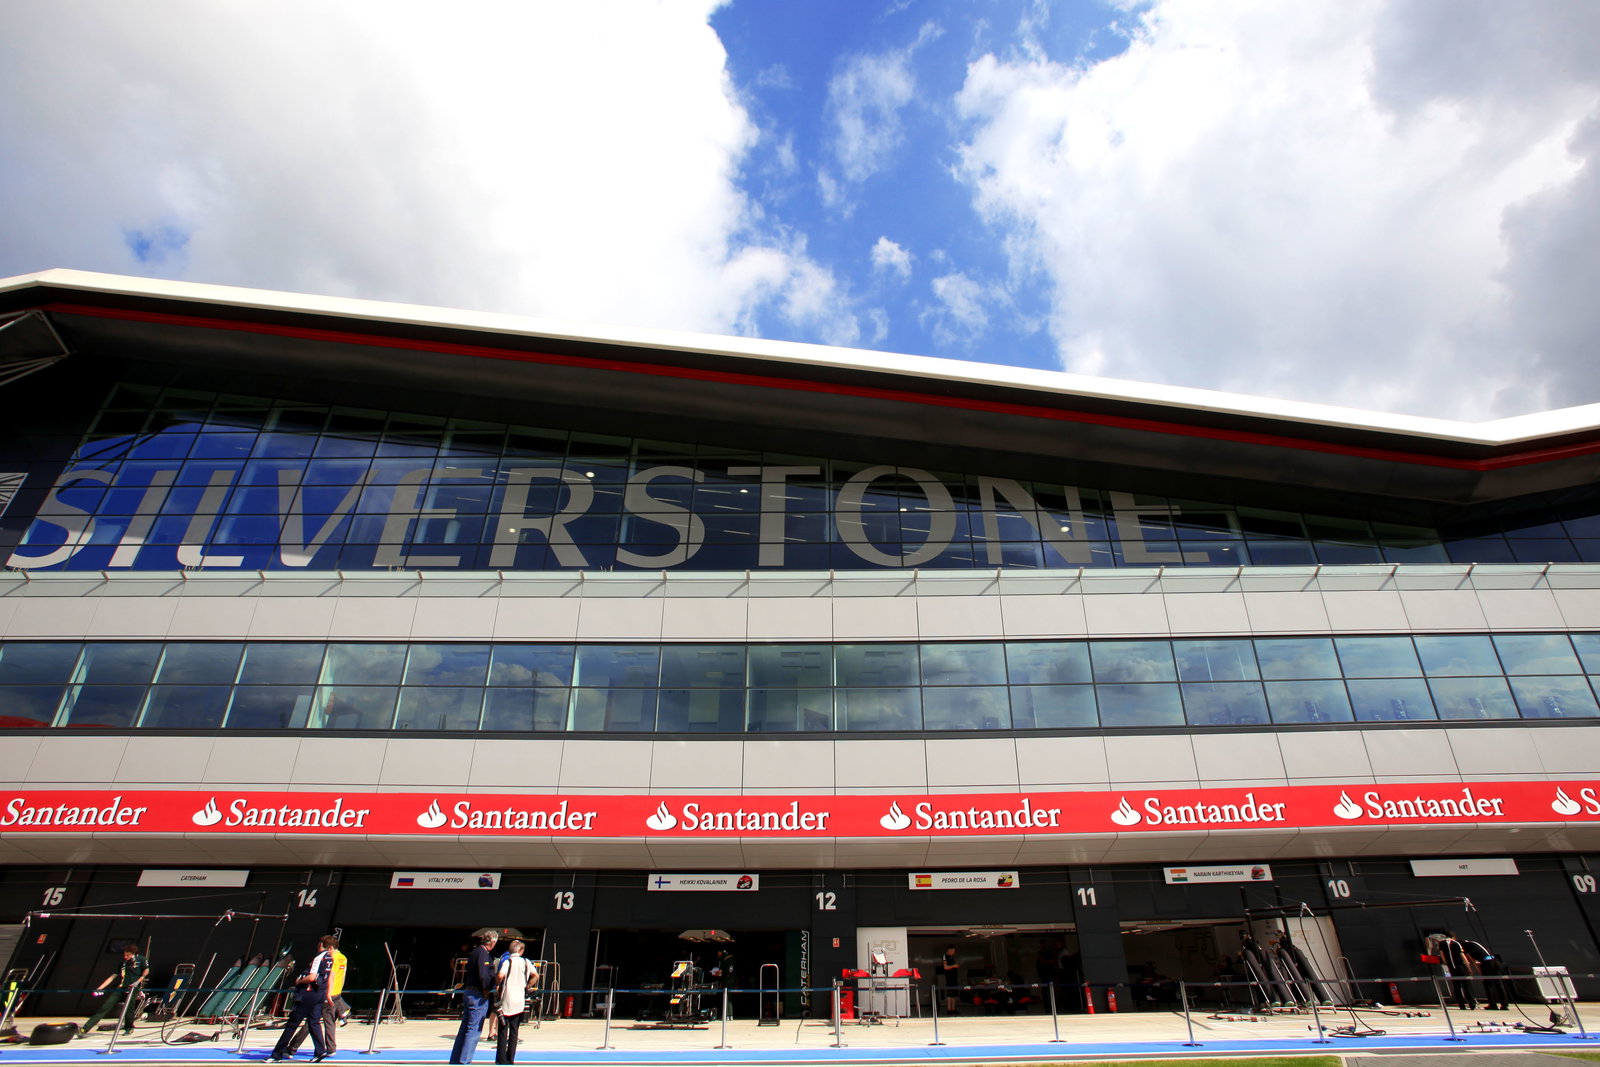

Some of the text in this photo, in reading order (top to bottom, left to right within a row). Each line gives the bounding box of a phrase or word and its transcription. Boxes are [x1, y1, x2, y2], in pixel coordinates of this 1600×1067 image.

[6, 466, 1209, 569] SILVERSTONE
[0, 796, 148, 826] Santander
[225, 798, 370, 828] Santander
[450, 800, 597, 830] Santander
[681, 800, 830, 831] Santander
[915, 798, 1061, 829] Santander
[1144, 793, 1286, 826] Santander
[1364, 788, 1505, 820] Santander
[42, 887, 67, 906] 15
[298, 890, 318, 907] 14
[1077, 887, 1097, 905] 11
[1328, 880, 1350, 898] 10
[1572, 874, 1596, 893] 09
[555, 892, 575, 909] 13
[816, 892, 837, 910] 12
